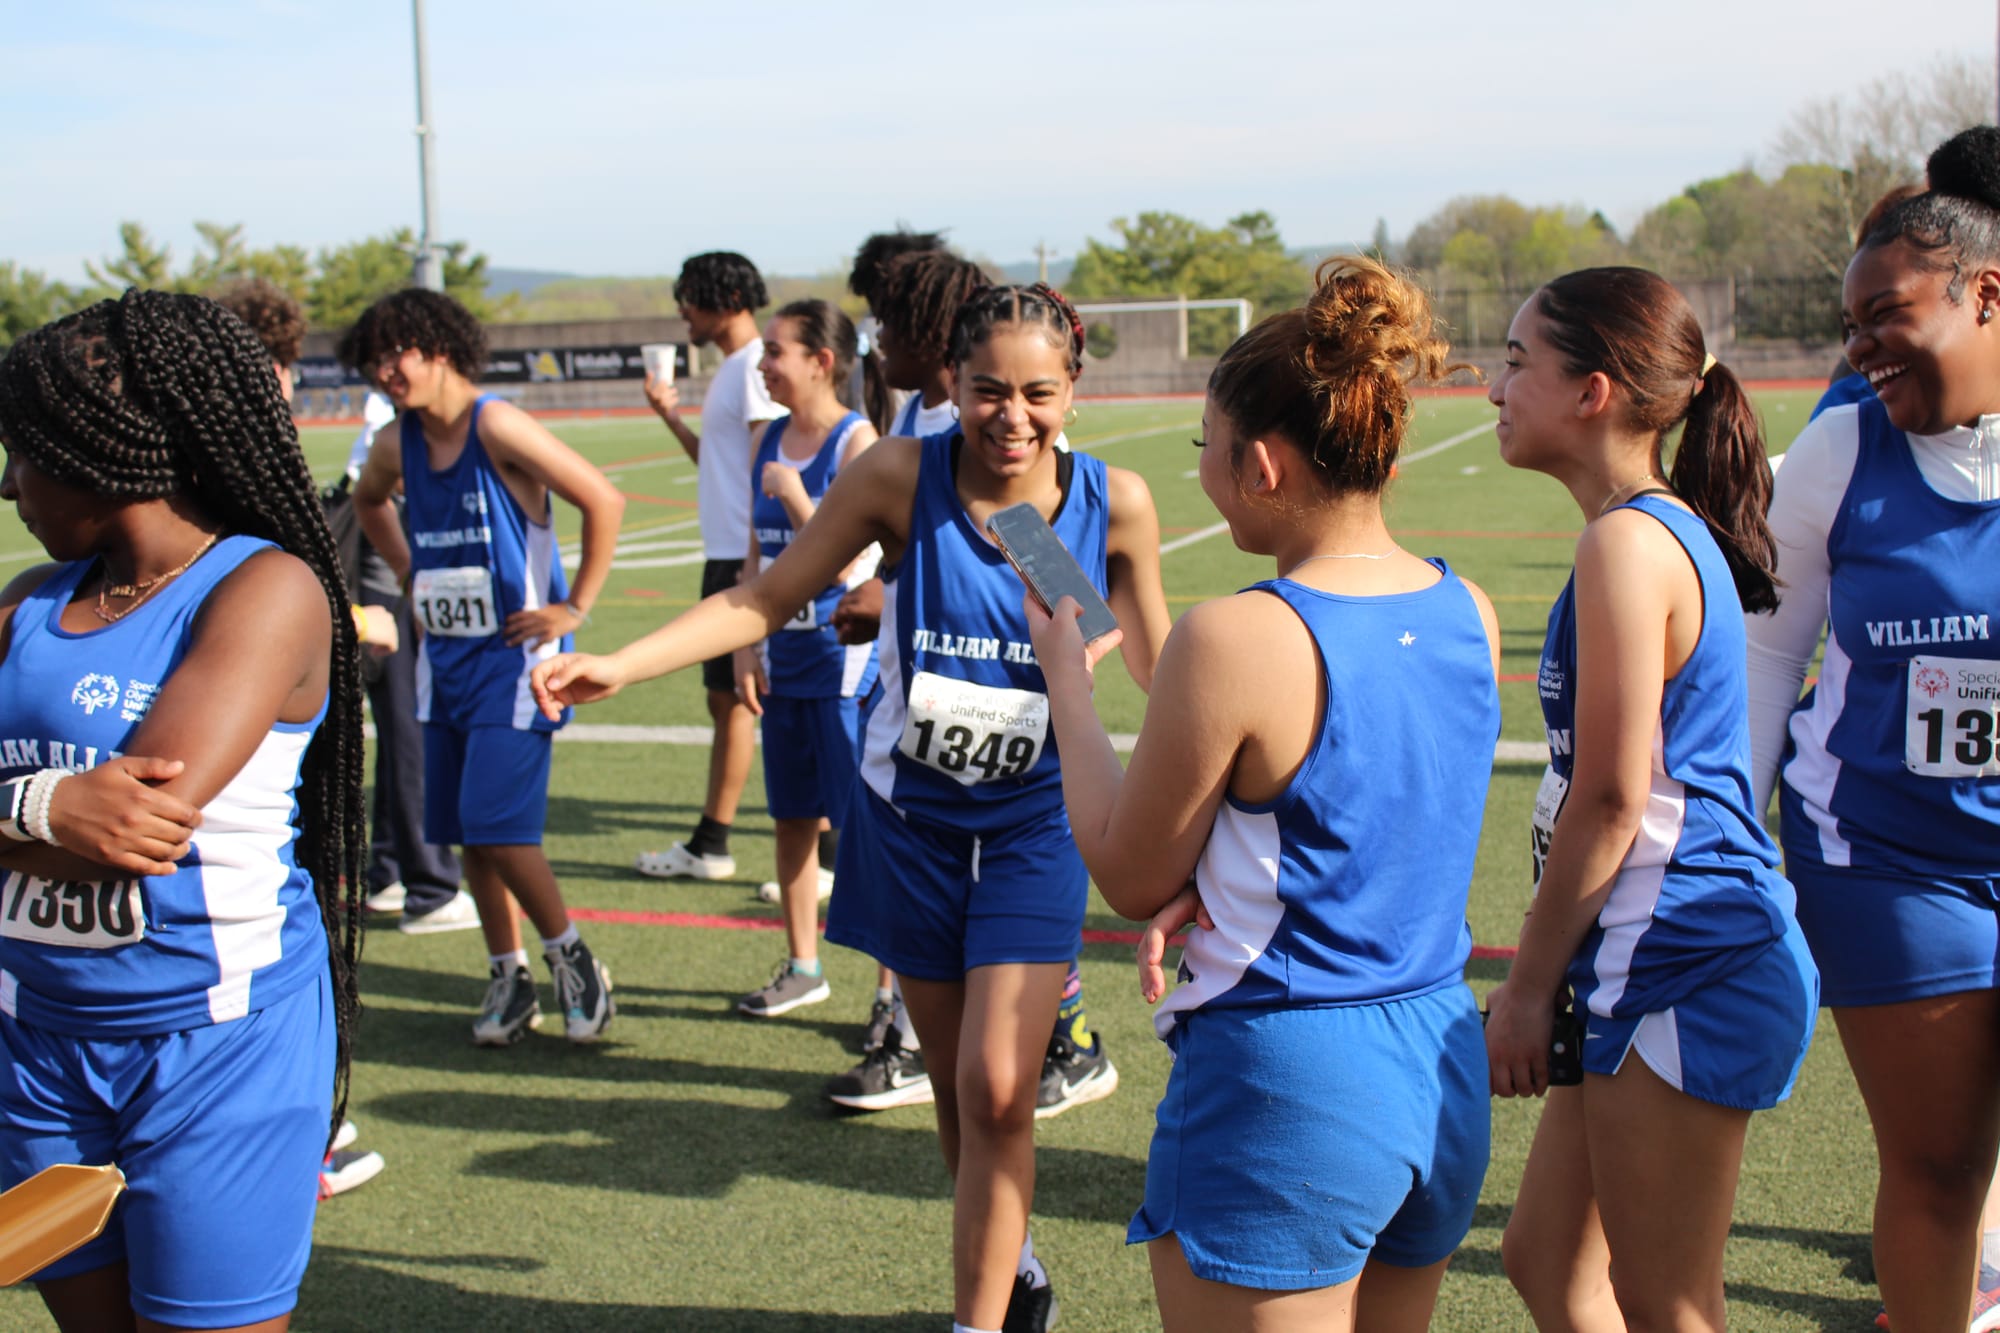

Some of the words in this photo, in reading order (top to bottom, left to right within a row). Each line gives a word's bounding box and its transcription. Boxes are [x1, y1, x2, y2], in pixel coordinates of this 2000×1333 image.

[421, 597, 487, 629] 1341
[1866, 614, 1990, 647] WILLIAM
[1003, 641, 1038, 666] AL
[950, 703, 997, 722] Unified
[998, 712, 1038, 728] Sports
[914, 719, 1036, 779] 1349
[1918, 708, 2000, 766] 13
[7, 872, 136, 938] 1350
